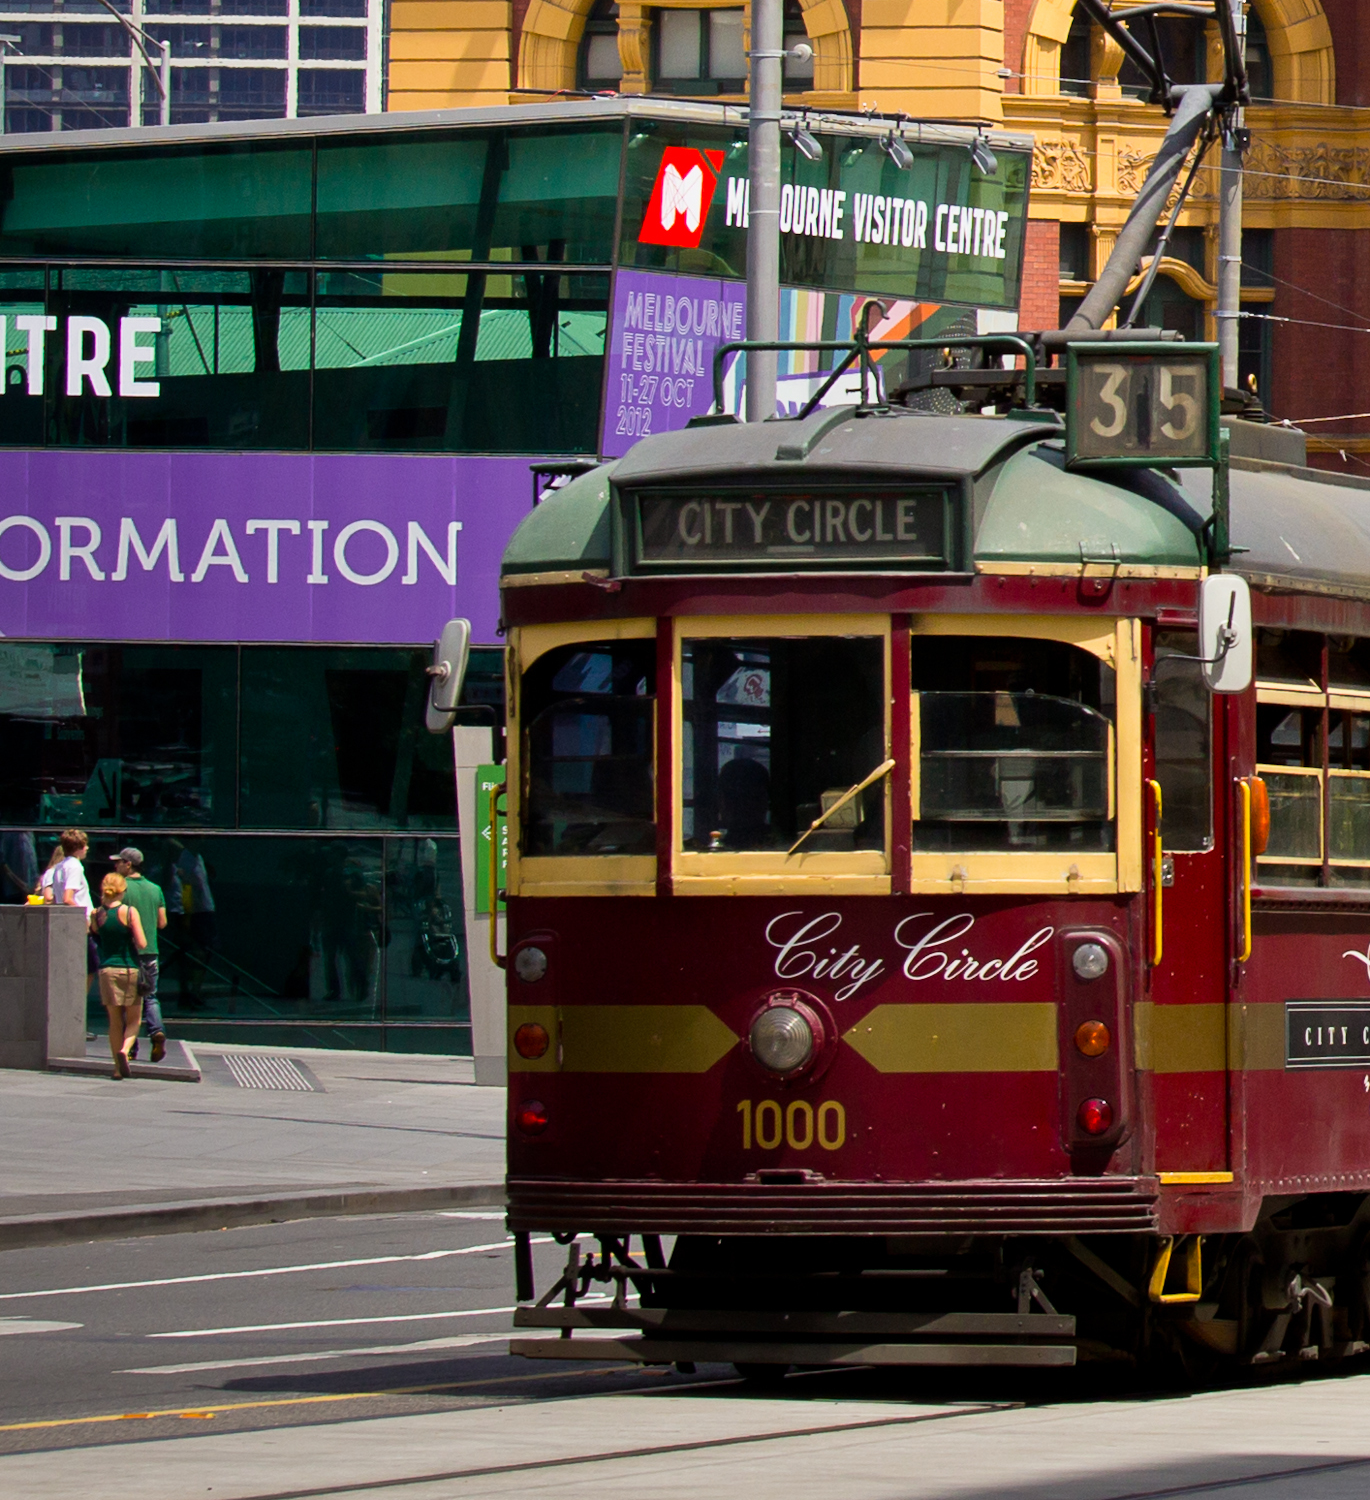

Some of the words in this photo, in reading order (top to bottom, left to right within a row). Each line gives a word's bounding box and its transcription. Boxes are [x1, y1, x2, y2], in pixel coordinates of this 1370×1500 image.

[725, 176, 847, 241] MOURNE
[853, 192, 928, 250] VISITOR
[934, 203, 1010, 259] CENTRE
[623, 291, 744, 340] MELBOURNE
[0, 314, 162, 398] TRE
[621, 332, 706, 377] FESTIVAL
[620, 372, 659, 405] 11-27
[660, 376, 695, 408] OCT
[615, 405, 652, 438] 2012
[678, 500, 768, 546] CITY
[785, 499, 918, 544] CIRCLE
[0, 515, 463, 586] ORMATION
[765, 911, 885, 1001] City
[894, 912, 1055, 981] Circle
[1304, 1026, 1348, 1046] CITY
[736, 1099, 846, 1151] 1000
